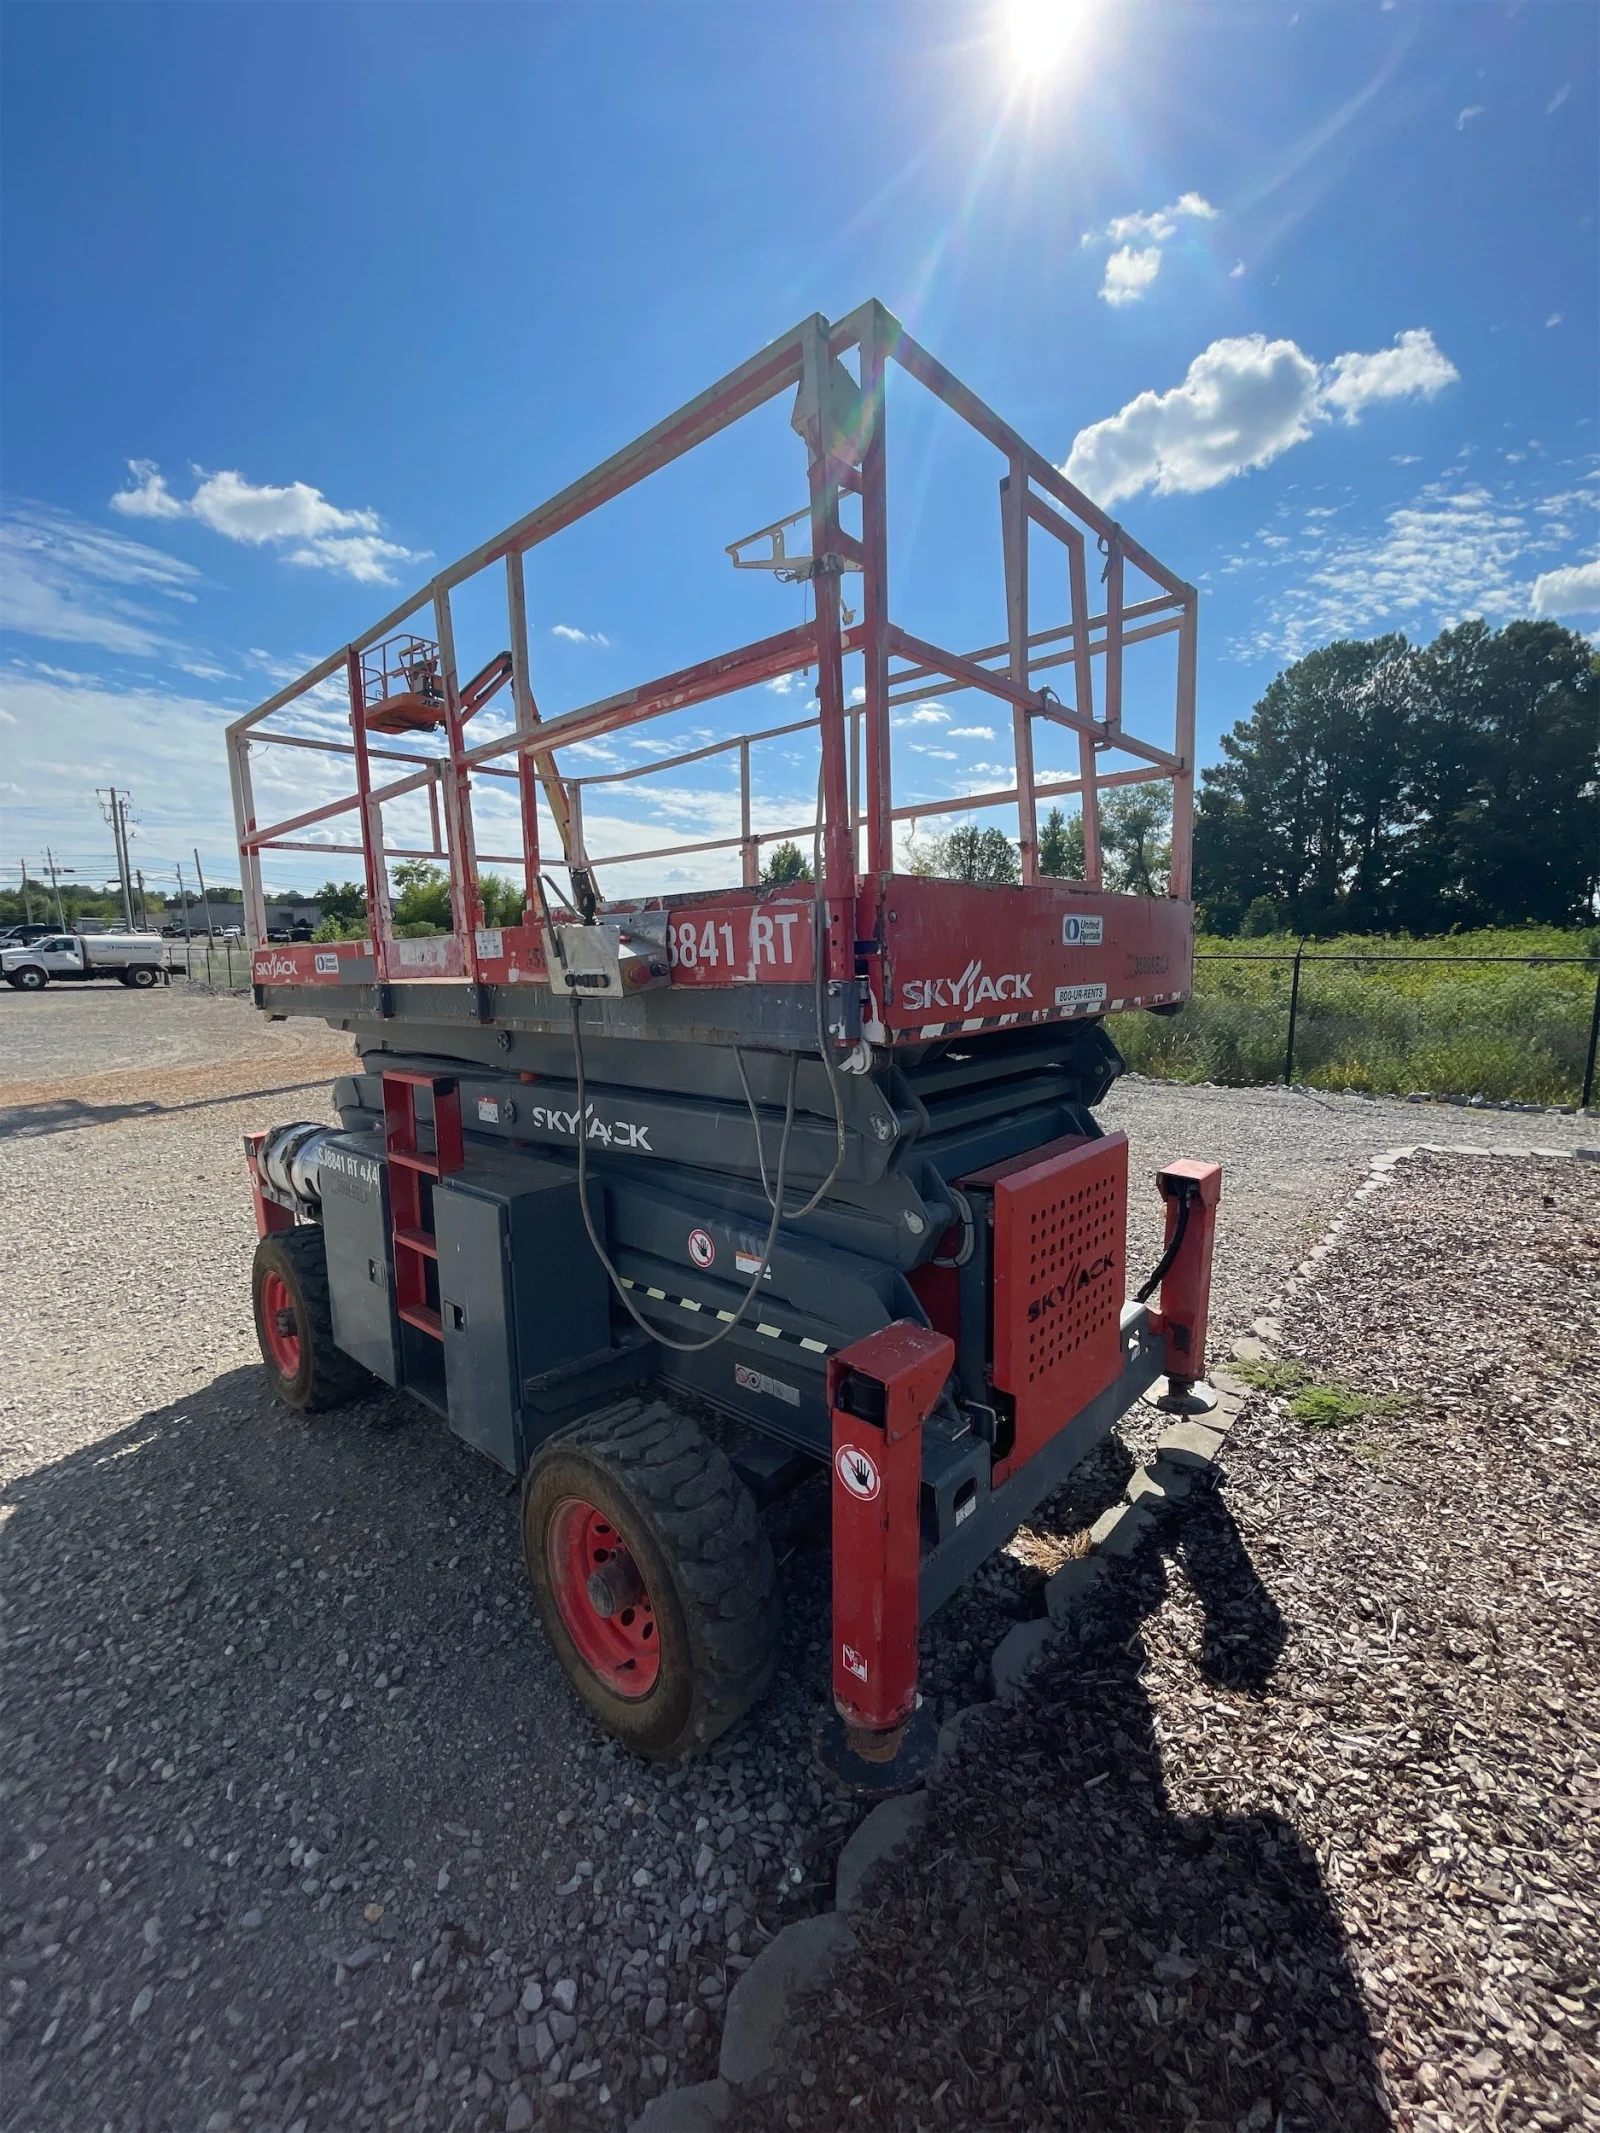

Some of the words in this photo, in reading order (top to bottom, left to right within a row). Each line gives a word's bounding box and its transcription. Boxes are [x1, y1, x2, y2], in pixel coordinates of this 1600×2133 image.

[421, 699, 440, 709] JLG
[751, 912, 799, 965] RT
[1080, 919, 1101, 931] United
[1080, 930, 1101, 942] Rentals
[255, 952, 298, 979] SKYJACK
[902, 958, 1034, 1012] SKYJACK
[1058, 987, 1103, 1002] 800-UR-RENTS
[318, 1147, 345, 1174] SJ8841
[347, 1157, 358, 1178] RT
[1027, 1250, 1116, 1324] SKYJACK
